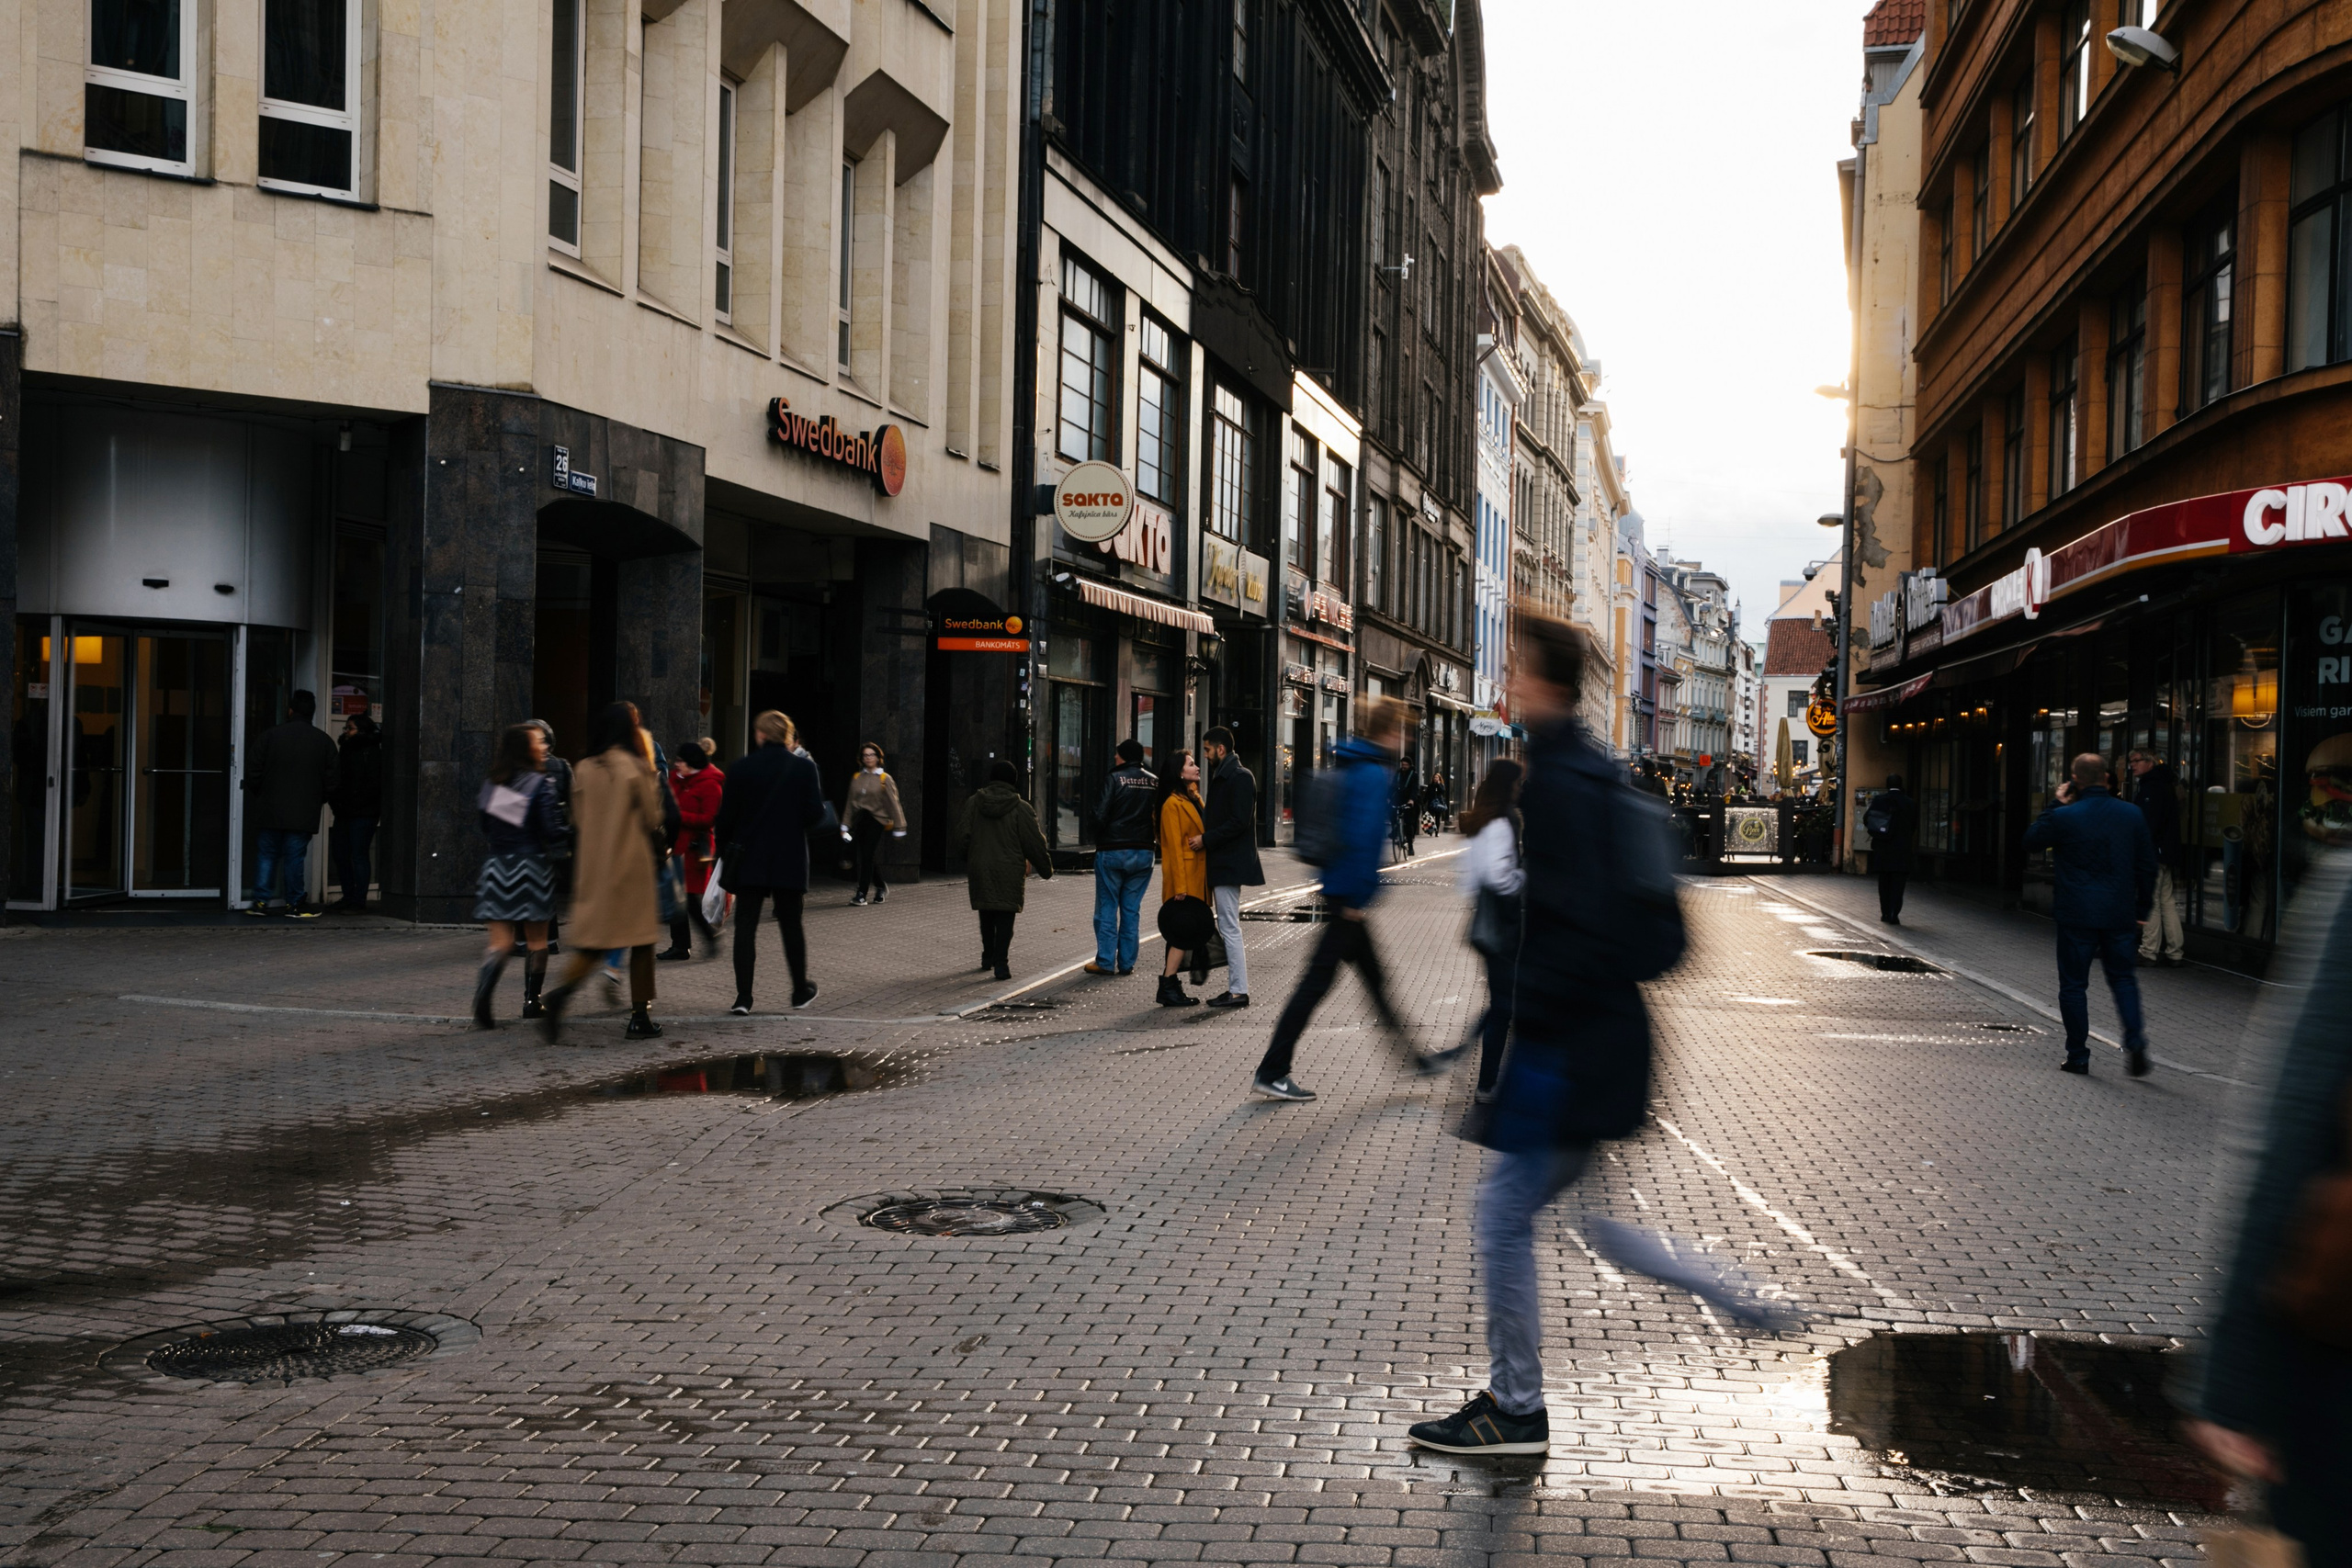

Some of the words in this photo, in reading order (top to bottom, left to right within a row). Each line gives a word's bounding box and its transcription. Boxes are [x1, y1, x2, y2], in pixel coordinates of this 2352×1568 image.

[772, 397, 878, 474] Swedbank
[556, 455, 568, 472] 26
[2244, 482, 2352, 546] CIR
[944, 618, 1004, 630] Swedbank
[975, 640, 1021, 649] BANKOMĀTS
[2294, 705, 2326, 717] Visiem
